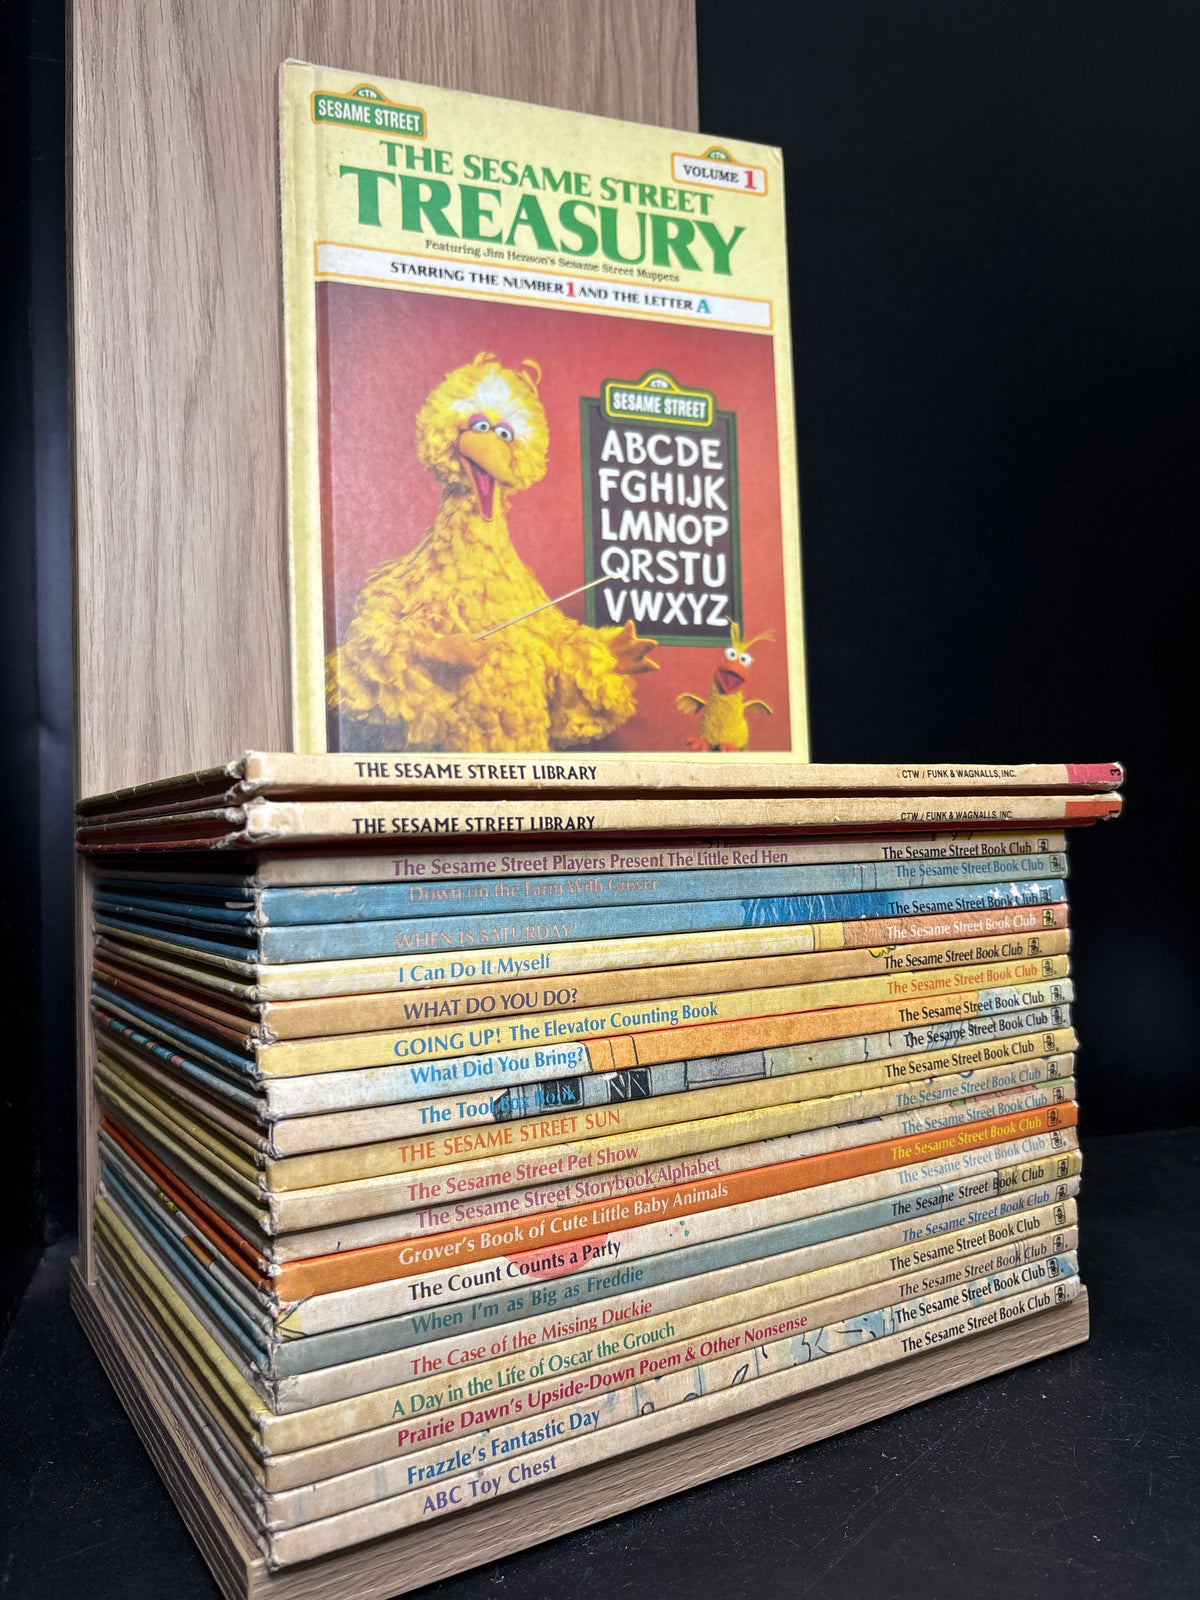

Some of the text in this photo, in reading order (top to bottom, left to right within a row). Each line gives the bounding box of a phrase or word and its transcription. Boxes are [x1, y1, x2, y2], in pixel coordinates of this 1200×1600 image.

[318, 99, 420, 131] SESAME STREET
[380, 140, 713, 216] THE SESAME STREET
[683, 164, 756, 189] VOLUME 1
[339, 165, 747, 276] TREASURY
[425, 240, 680, 283] Featuring Jim Henson's Sesame Street Muppets
[390, 261, 711, 314] STARRING THE NUMBER 1 AND THE LETTER A
[613, 392, 706, 419] SESAME STREET
[601, 429, 723, 470] ABCDE
[598, 468, 728, 511] FGHIJK
[601, 508, 728, 547] LMNOP
[601, 546, 726, 588] QRSTU
[603, 588, 729, 626] VWXYZ
[355, 762, 597, 780] THE SESAME STREET LIBRARY
[901, 770, 920, 779] CTW
[927, 769, 948, 778] FUNK
[950, 770, 955, 778] &
[1001, 769, 1016, 778] INC.
[1110, 768, 1121, 777] 3
[352, 816, 595, 834] THE SESAME STREET LIBRARY
[392, 850, 788, 876] The Sesame Street Players Present The Little Red Hen
[394, 922, 579, 949] WHEN IS SATURDAY?
[884, 943, 1023, 970] The Sesame Street Book Club
[399, 953, 551, 982] I Can Do It Myself
[404, 988, 578, 1020] WHAT DO YOU DO?
[394, 1002, 718, 1058] GOING UP! The Elevator Counting Book
[410, 1046, 583, 1085] What Did You Bring?
[885, 1040, 1035, 1078] The Sesame Street Book Club
[398, 1109, 621, 1163] THE SESAME STREET SUN
[891, 1117, 1042, 1160] The Sesame Street Book Club
[407, 1144, 638, 1202] The Sesame Street Pet Show
[399, 1183, 729, 1266] Grover's Book of Cute Little Baby Animals
[409, 1239, 622, 1301] The Count Counts a Party
[412, 1268, 644, 1334] When I'm as Big as Freddie
[410, 1299, 653, 1376] The Case of the Missing Duckie
[901, 1294, 1051, 1353] The Sesame Street Book Club
[391, 1322, 676, 1419] A Day in the Life of Oscar the Grouch
[397, 1313, 808, 1447] Prairie Dawn's Upside-Down Poem & Other Nonsense
[407, 1409, 600, 1484] Frazzle's Fantastic Day
[422, 1454, 558, 1515] ABC Toy Chest
